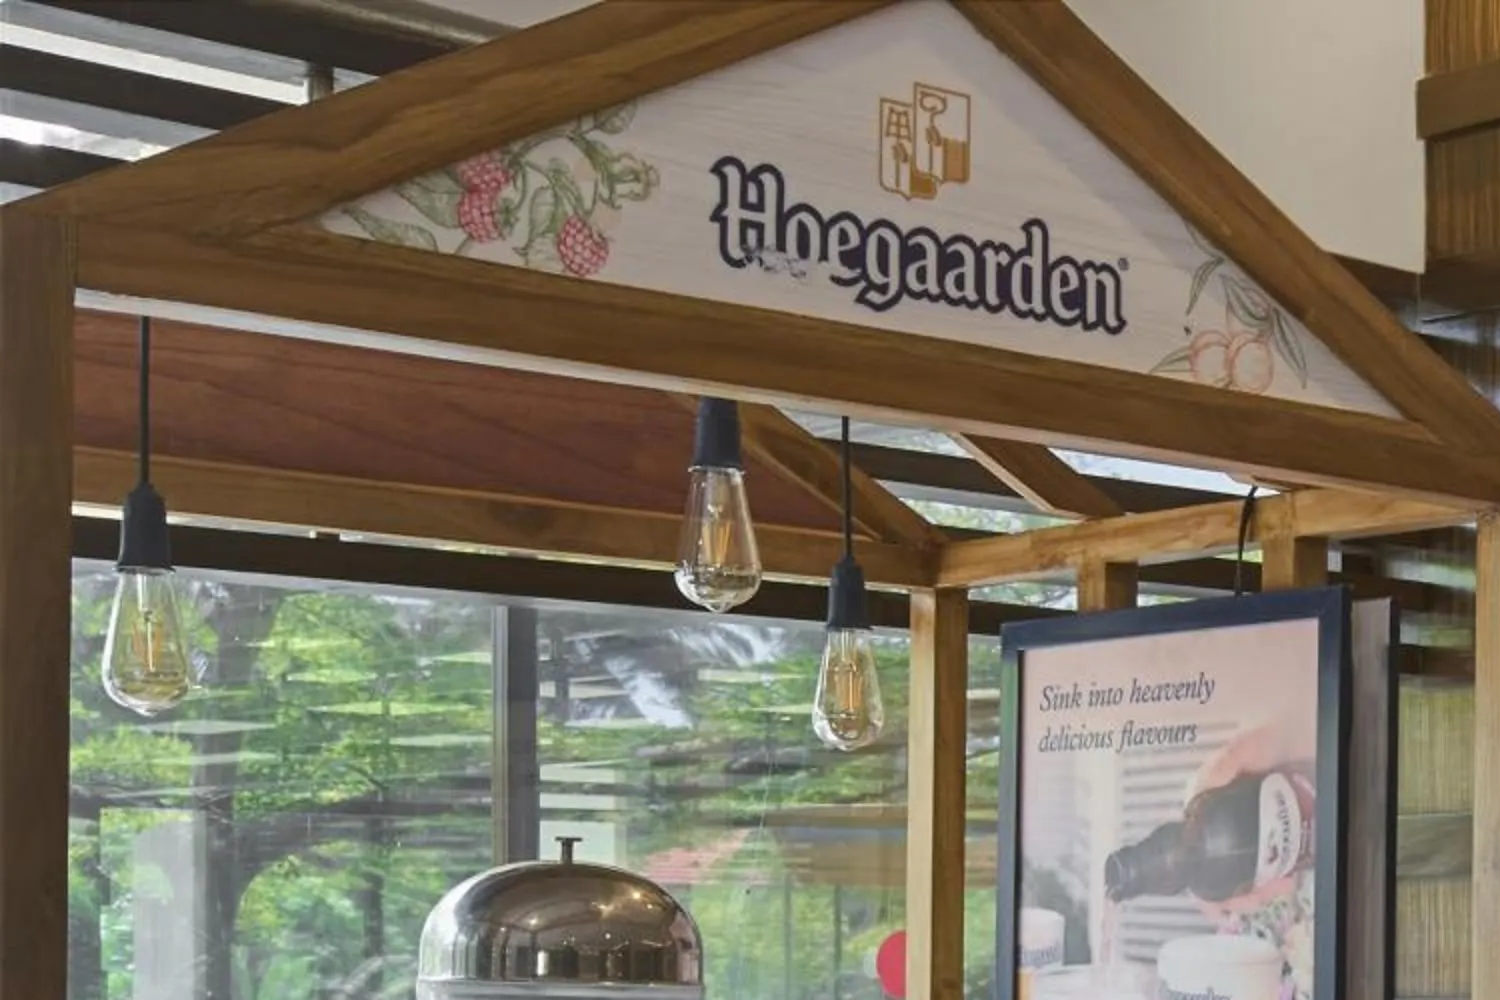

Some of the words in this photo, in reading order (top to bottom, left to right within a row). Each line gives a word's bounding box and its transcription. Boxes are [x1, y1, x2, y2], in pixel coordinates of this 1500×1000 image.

[709, 155, 1126, 336] Hoegaarden
[1039, 681, 1083, 713] Sink
[1088, 674, 1124, 706] into
[1129, 671, 1215, 705] heavenly
[1037, 722, 1114, 755] delicious
[1116, 718, 1198, 753] flavours
